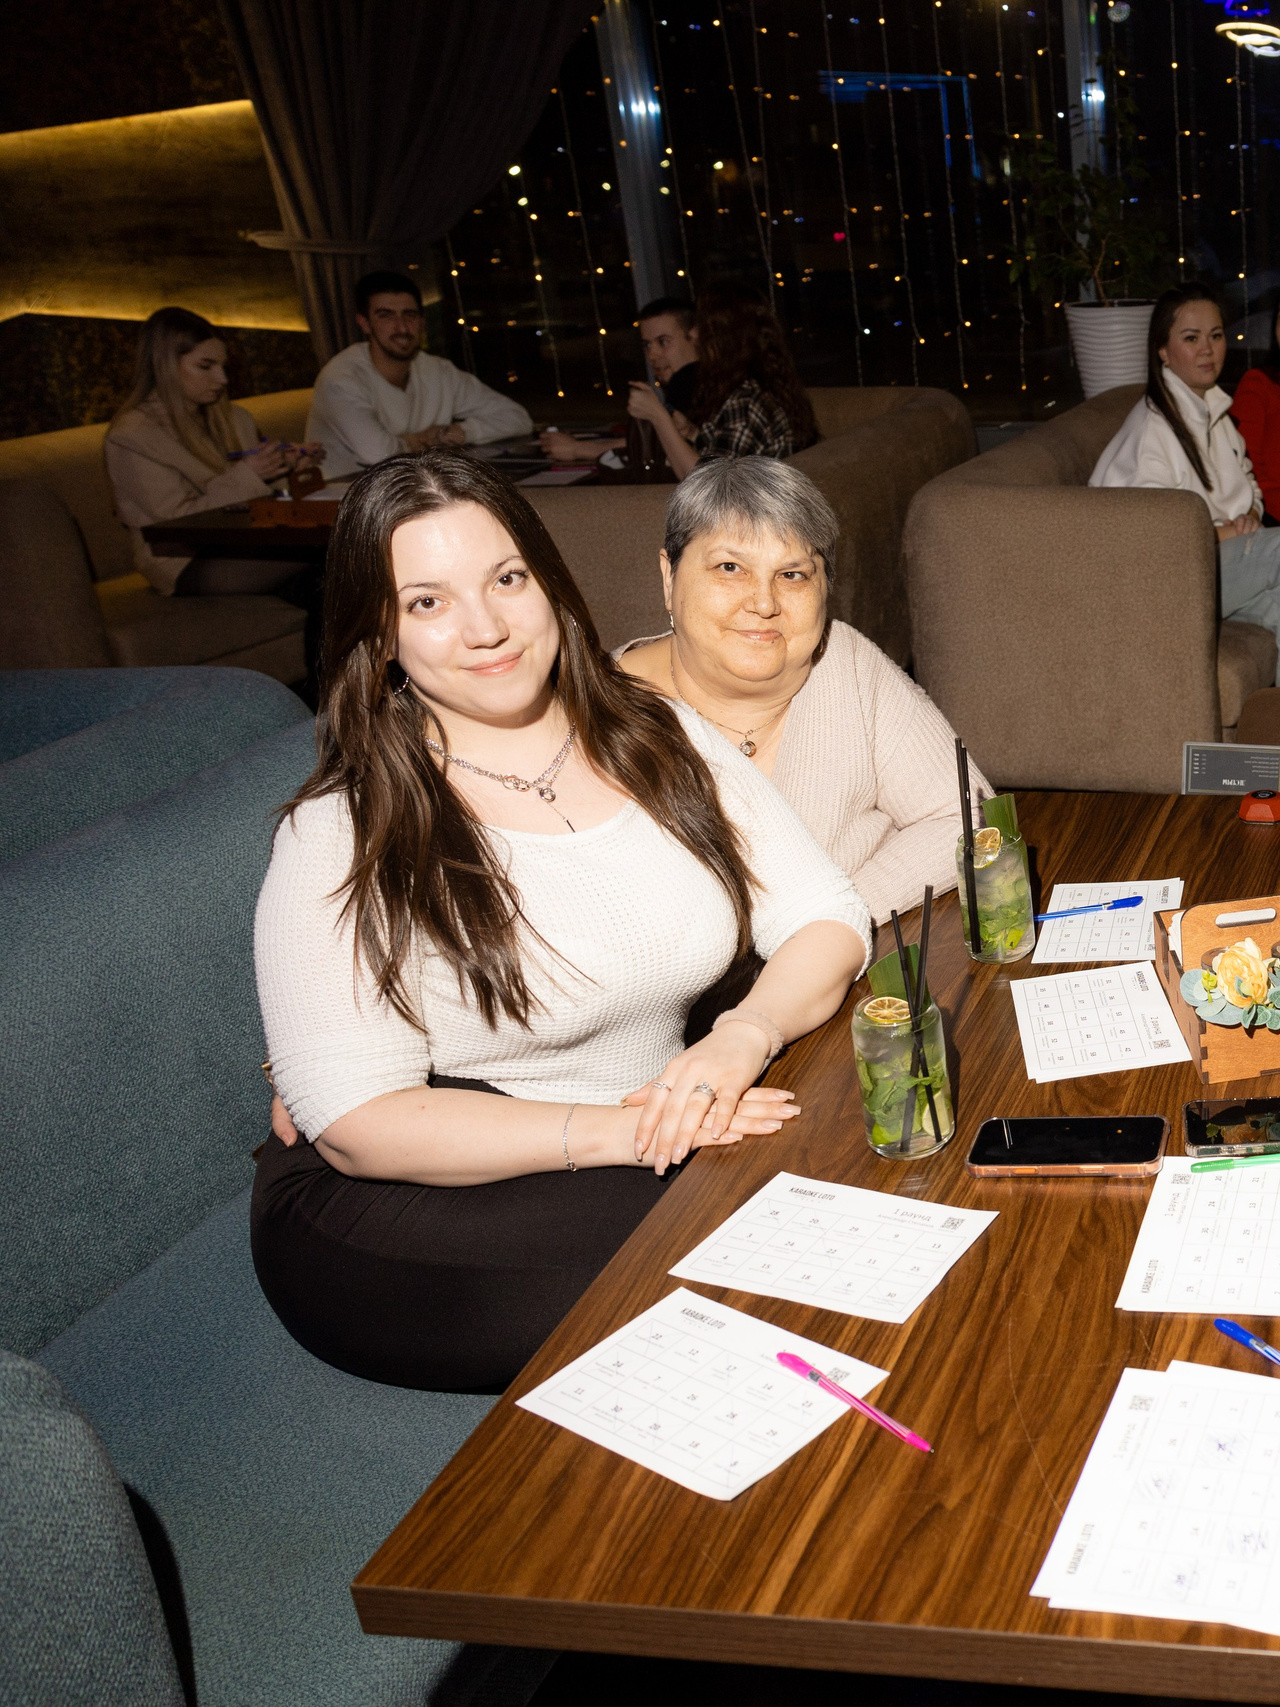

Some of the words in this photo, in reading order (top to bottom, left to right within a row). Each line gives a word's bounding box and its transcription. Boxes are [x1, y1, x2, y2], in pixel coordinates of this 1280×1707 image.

[789, 1187, 819, 1198] KARAOKE
[817, 1193, 836, 1201] LOTO
[1167, 1192, 1180, 1212] раунд
[899, 1211, 932, 1222] раунд
[1147, 1259, 1159, 1272] LOTO
[1141, 1272, 1156, 1294] KARAOKE
[681, 1308, 710, 1323] KARAOKE
[706, 1318, 726, 1329] LOTO
